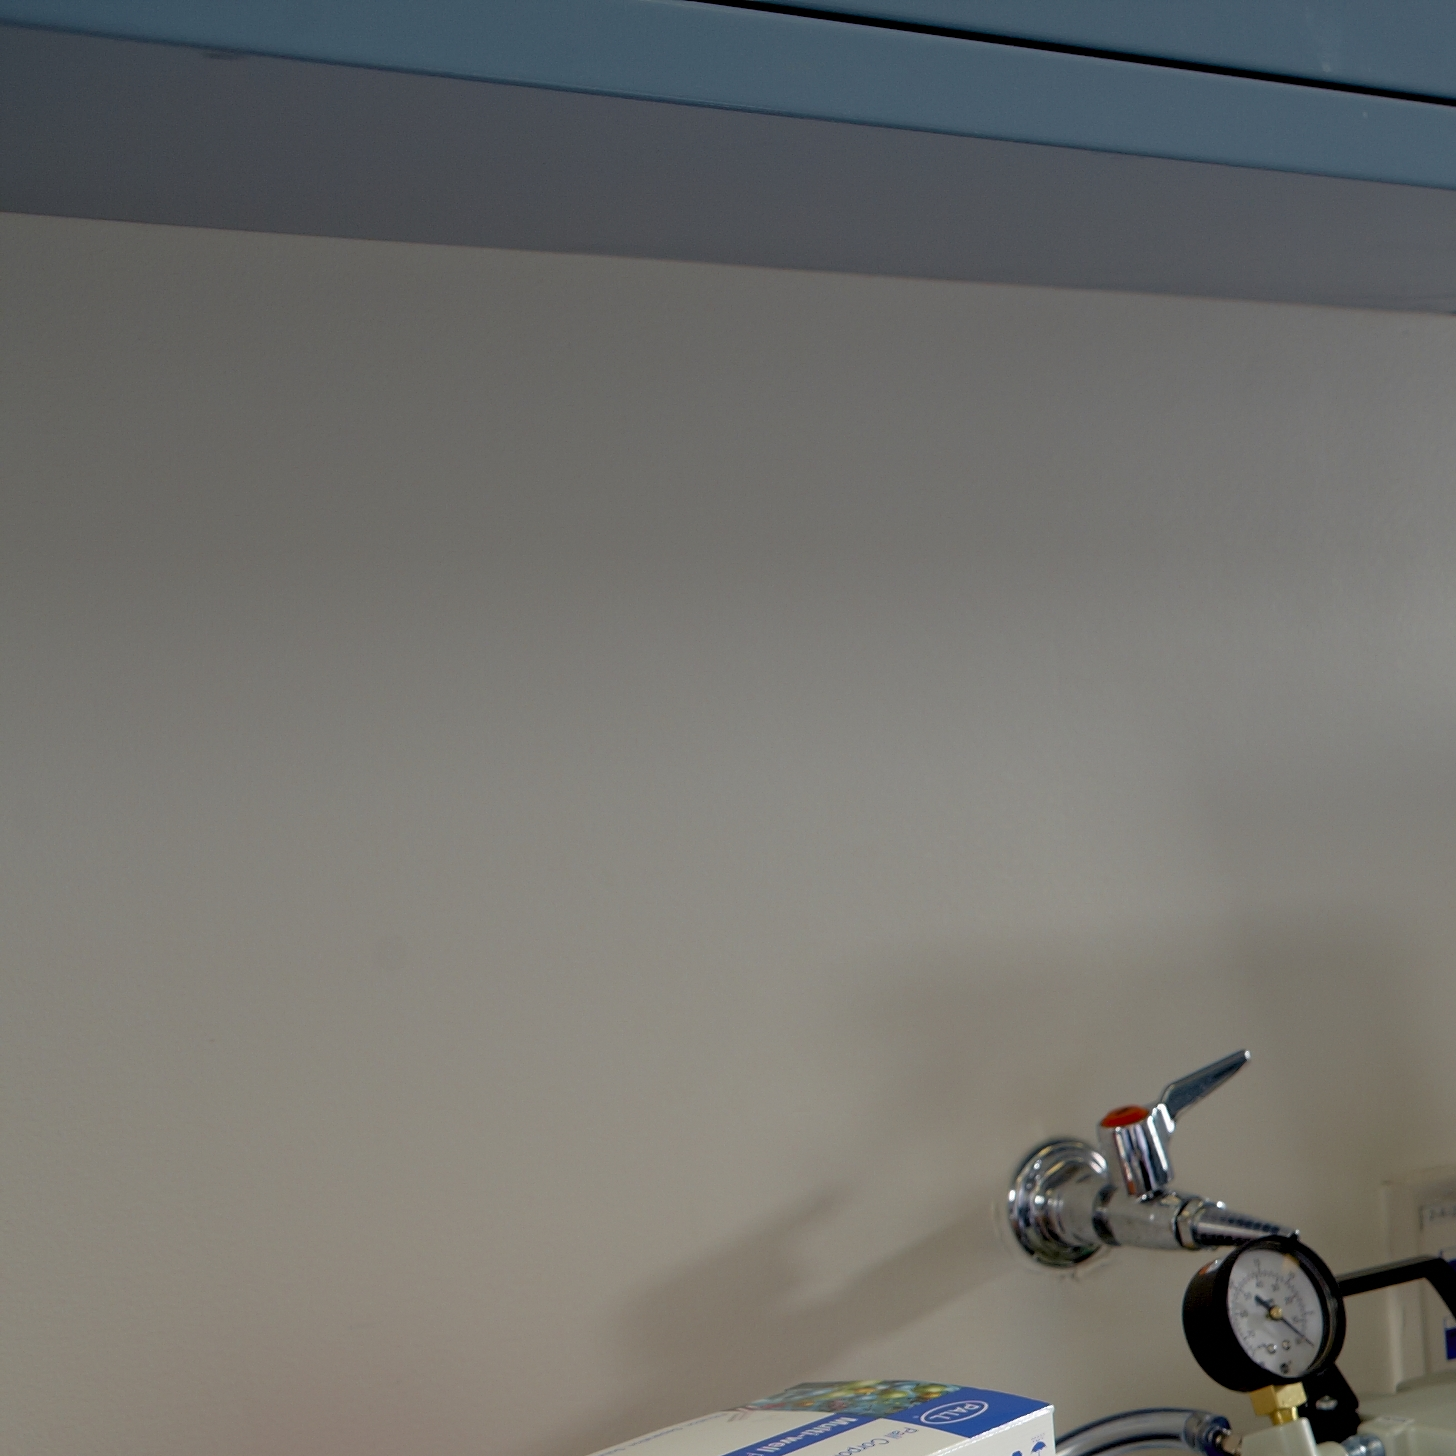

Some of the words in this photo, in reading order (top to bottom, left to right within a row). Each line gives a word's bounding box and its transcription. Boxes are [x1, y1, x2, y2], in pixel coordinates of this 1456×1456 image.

[929, 1402, 980, 1421] PALL
[756, 1416, 858, 1453] Multi-well
[884, 1426, 919, 1440] Pall
